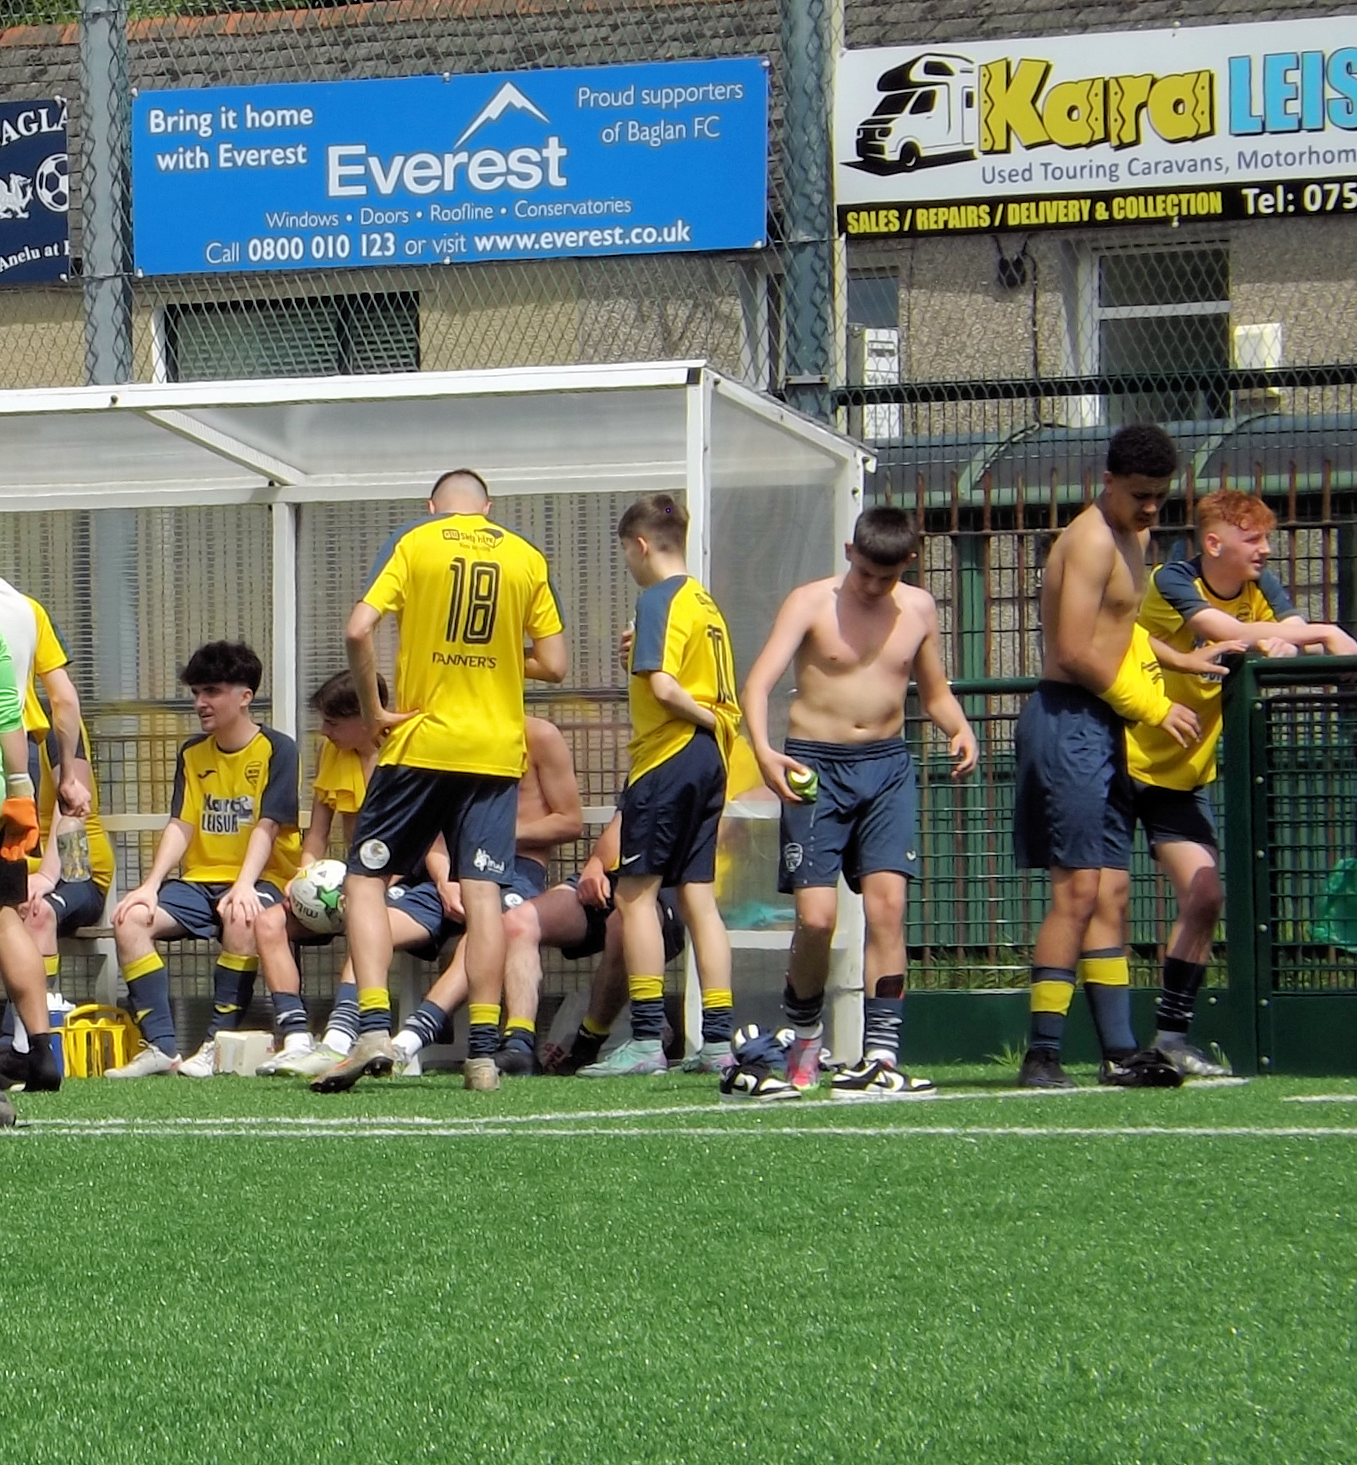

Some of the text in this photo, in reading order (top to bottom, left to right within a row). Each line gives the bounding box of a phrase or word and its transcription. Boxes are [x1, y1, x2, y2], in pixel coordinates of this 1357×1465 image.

[578, 82, 744, 109] Proud supporters
[979, 46, 1357, 154] Kara LEIS
[149, 104, 314, 138] Bring it home
[601, 115, 721, 147] of Baglan FC
[156, 143, 308, 171] with Everest
[328, 136, 568, 197] Everest
[982, 162, 1033, 185] Used
[1041, 159, 1119, 182] Touring
[1127, 155, 1230, 176] Caravans,
[265, 197, 632, 229] Windows Doors Roofline Conservatories
[846, 208, 900, 234] SALES
[916, 204, 991, 231] REPAIRS
[1007, 199, 1091, 226] DELIVERY
[1095, 201, 1109, 221] &
[1113, 191, 1223, 222] COLLECTION
[1241, 182, 1357, 215] Tel: 075
[44, 241, 60, 257] at
[206, 219, 691, 264] Call 0800 010 123 or visit www.everest.co.uk
[446, 557, 500, 644] 18
[432, 652, 497, 669] TANNER'S
